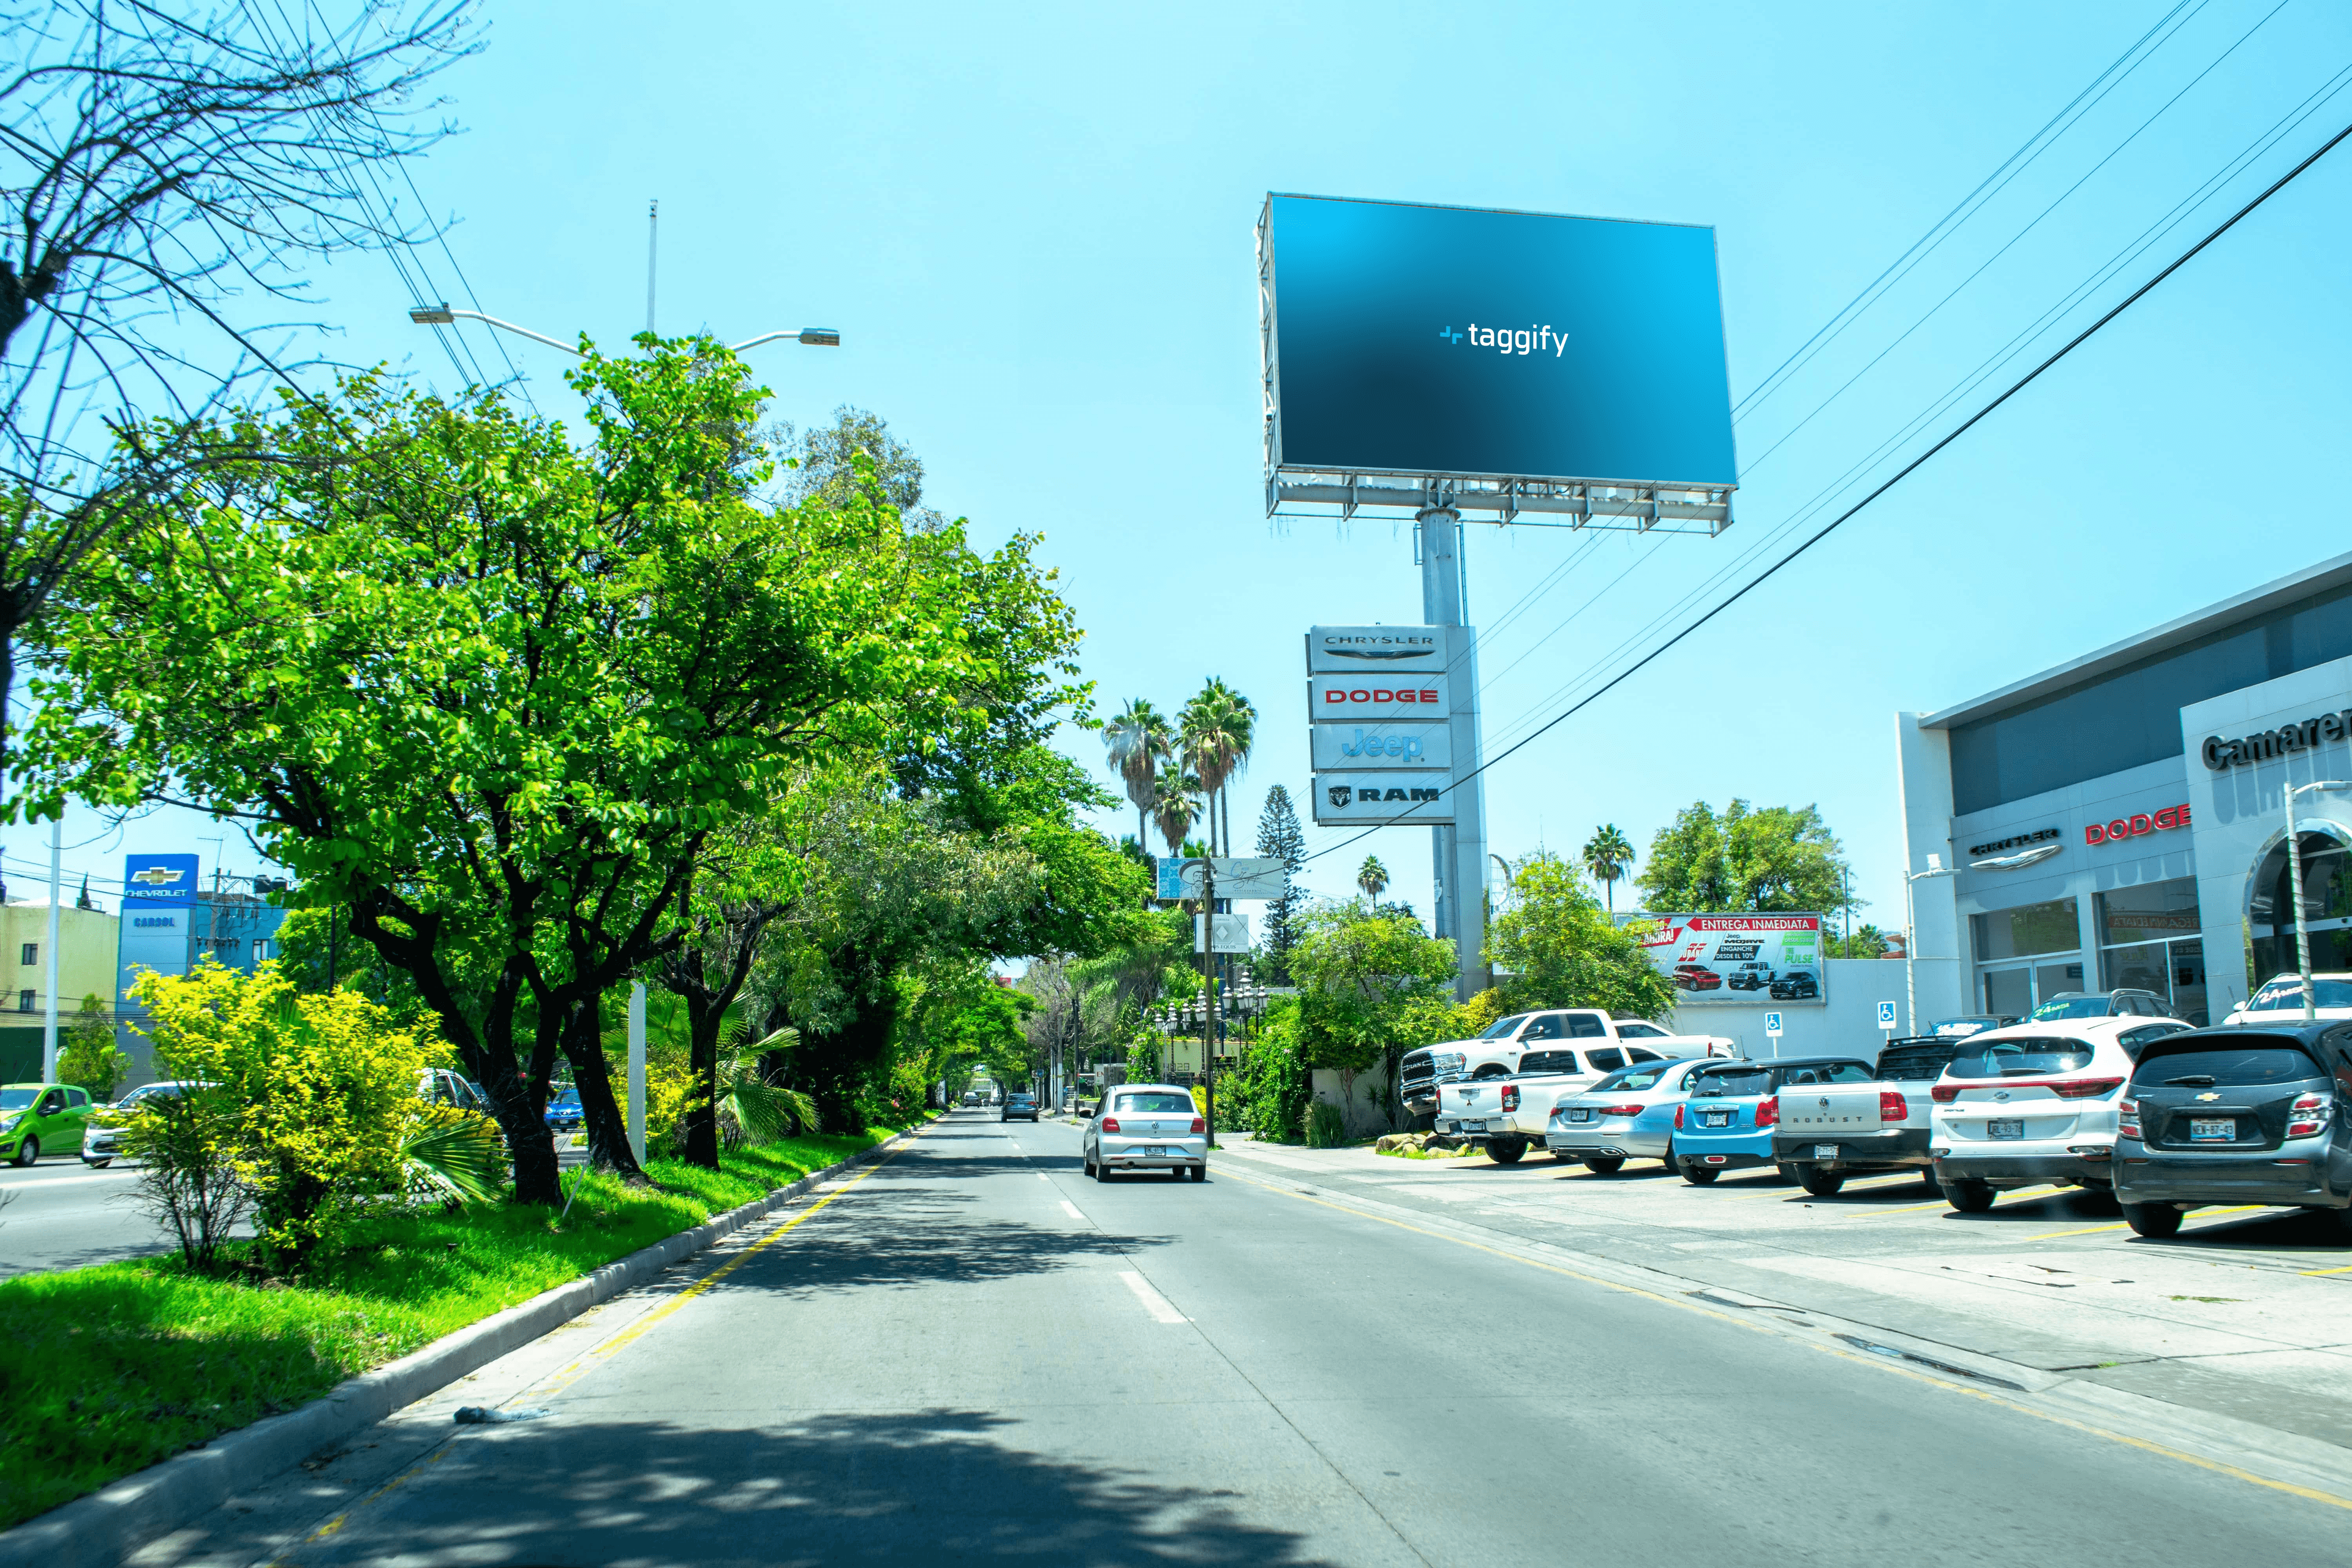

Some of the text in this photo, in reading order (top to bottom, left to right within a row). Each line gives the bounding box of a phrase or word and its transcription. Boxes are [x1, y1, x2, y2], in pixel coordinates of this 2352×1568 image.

[1468, 323, 1569, 357] taggify
[1325, 636, 1433, 645] CHRYSLER
[1325, 690, 1439, 703] DODGE
[1342, 729, 1423, 762] Jeep
[1358, 788, 1439, 802] RAM
[2085, 804, 2192, 845] DODGE
[1969, 828, 2060, 855] CHRYSLER
[1702, 919, 1810, 929] ENTREGA INMEDIATA
[1784, 954, 1814, 963] PULSE
